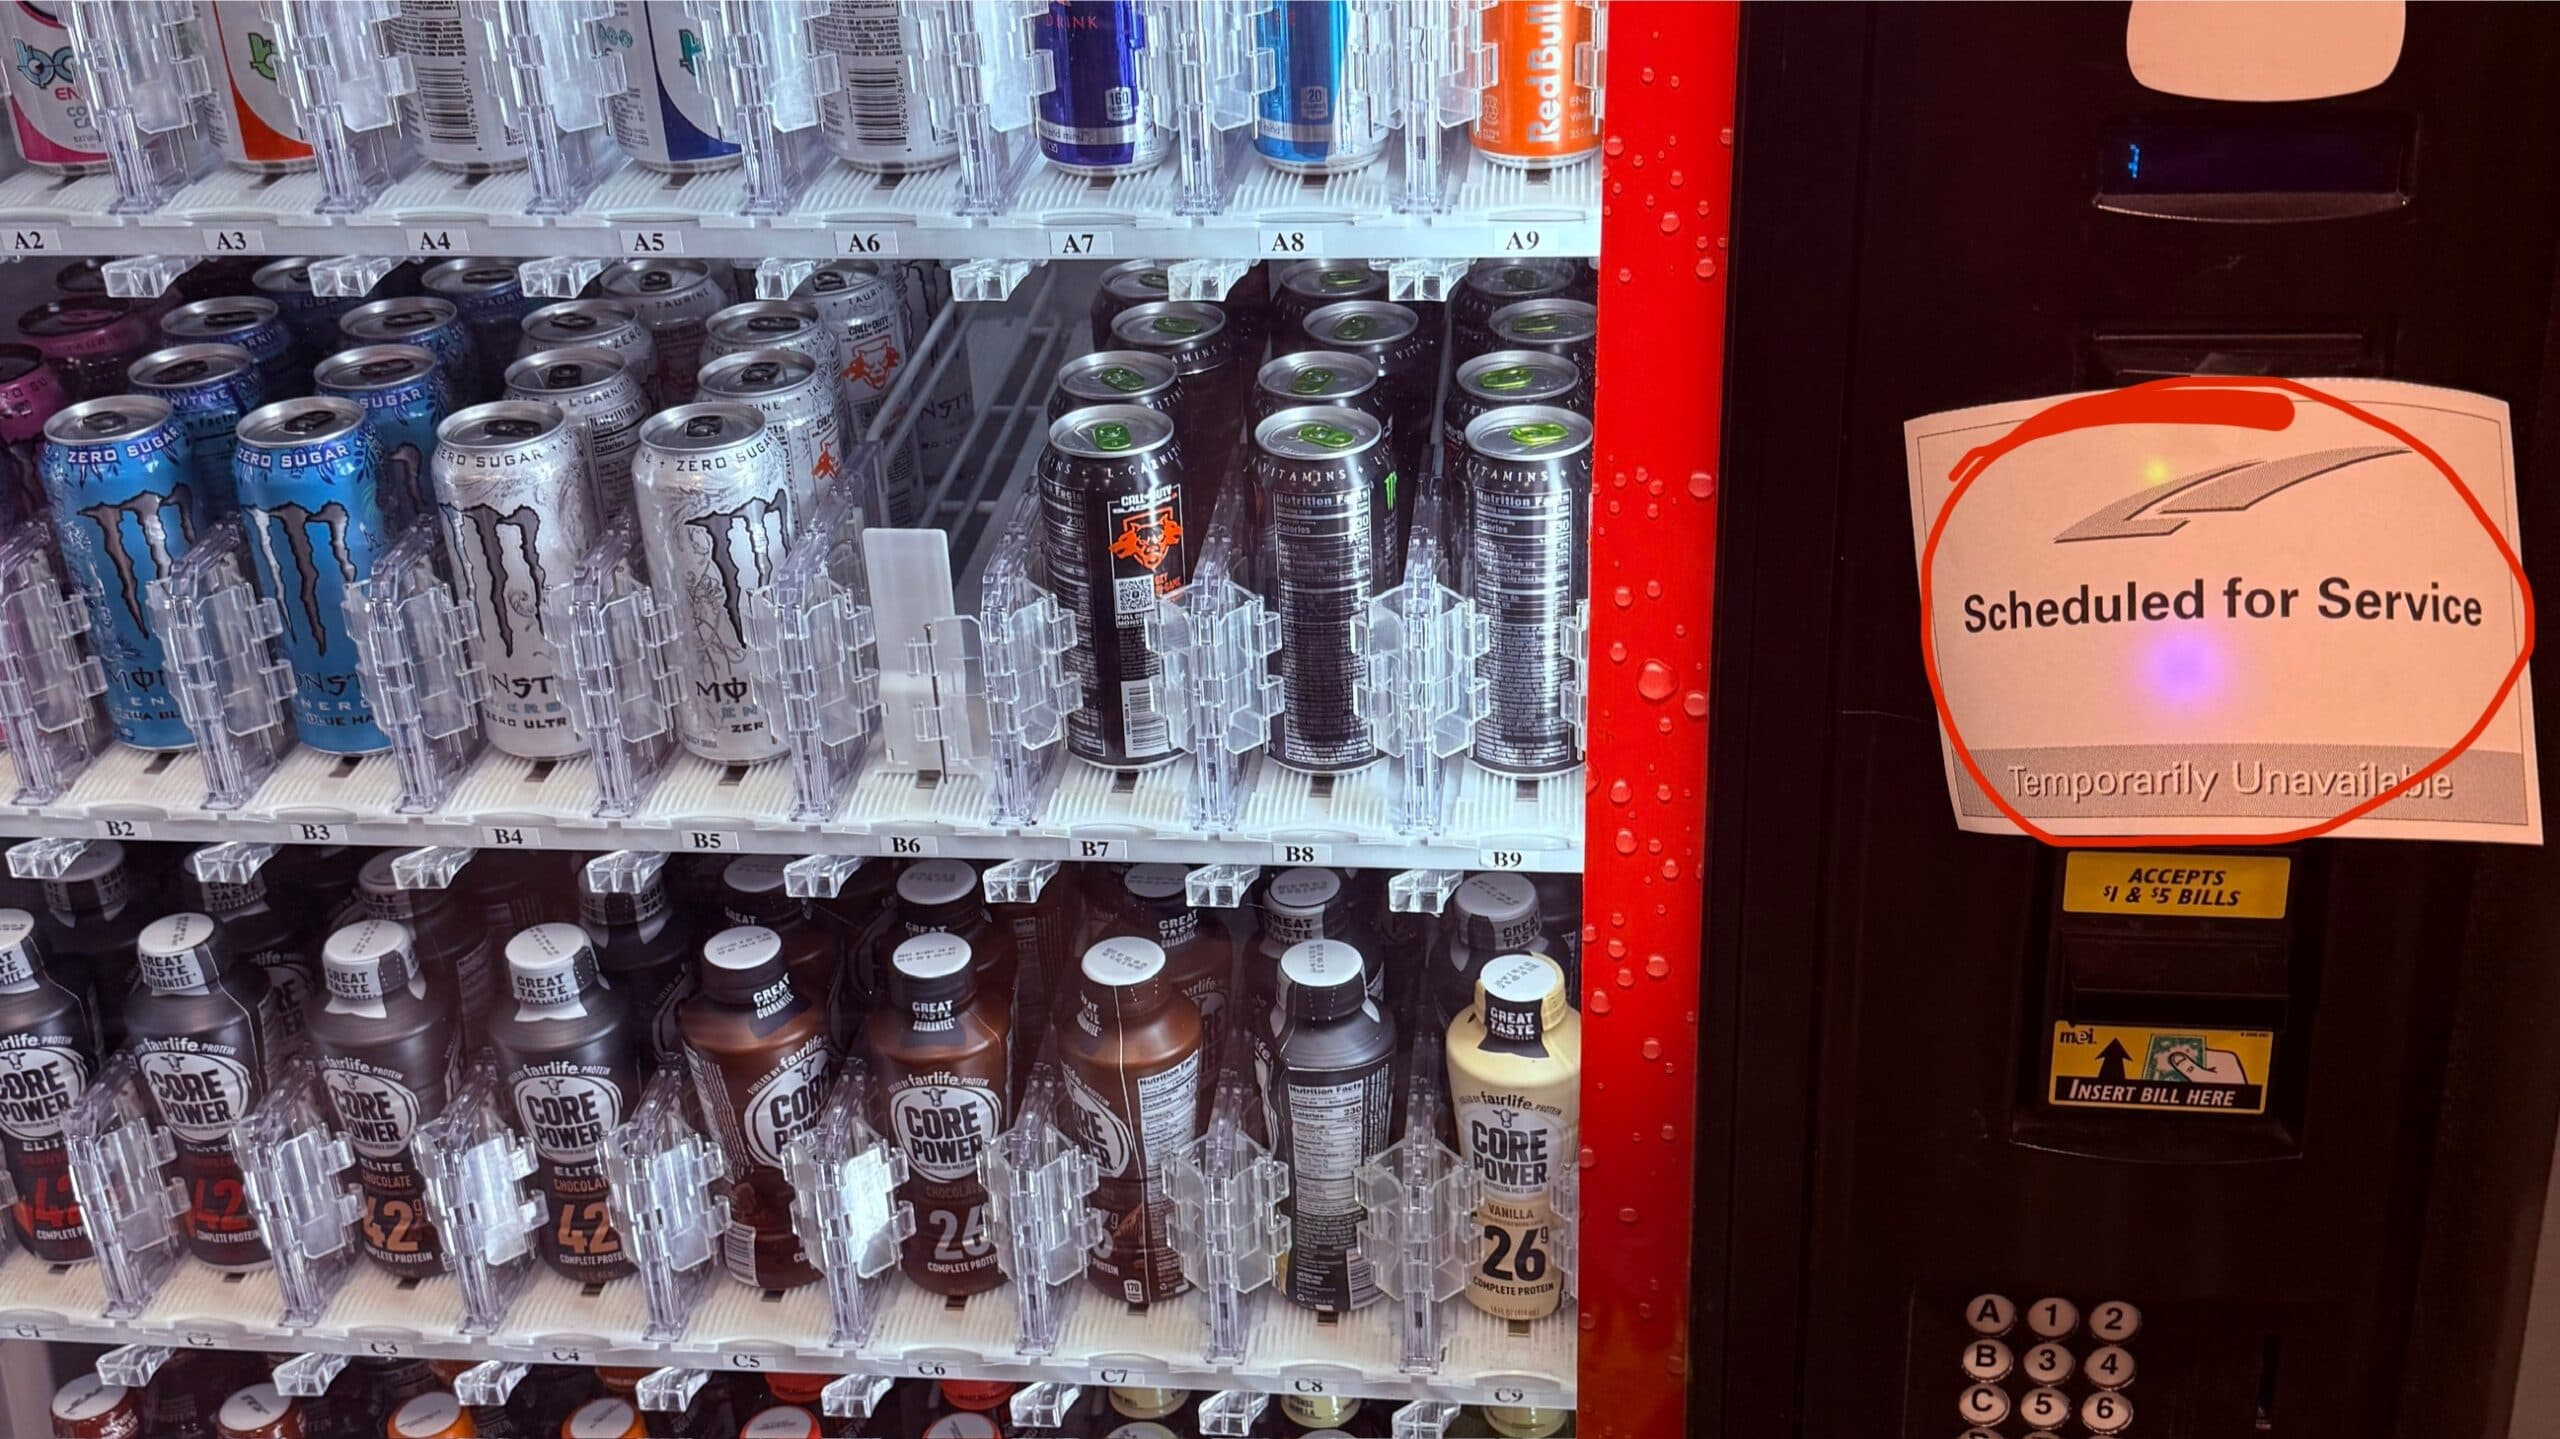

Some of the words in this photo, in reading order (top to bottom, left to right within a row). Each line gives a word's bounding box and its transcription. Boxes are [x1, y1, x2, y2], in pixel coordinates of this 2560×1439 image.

[1110, 92, 1129, 106] 160
[1308, 90, 1321, 102] 20
[14, 232, 44, 250] A2
[217, 232, 246, 250] A3
[420, 232, 450, 250] A4
[634, 234, 663, 252] A5
[849, 234, 880, 252] A6
[1064, 234, 1093, 253] A7
[1272, 233, 1304, 251] A8
[1507, 232, 1539, 250] A9
[68, 449, 117, 463] ZERO
[126, 426, 180, 457] SUGAR
[238, 448, 271, 467] ZERO
[281, 444, 348, 468] SUGAR
[477, 449, 544, 468] SUGAR
[676, 460, 727, 472] ZERO
[1262, 463, 1346, 482] VITAMINS
[1277, 493, 1332, 506] Nutrition
[1477, 492, 1530, 507] Nutrition
[1964, 577, 2205, 633] Scheduled
[2224, 576, 2299, 619] for
[2318, 575, 2484, 627] Service
[2009, 764, 2218, 803] Temporarily
[2233, 762, 2455, 800] Unavailable
[108, 821, 135, 837] B2
[302, 824, 330, 840] B3
[496, 830, 523, 845] B4
[694, 832, 721, 848] B5
[893, 838, 920, 853] B6
[1081, 841, 1109, 857] B7
[1285, 846, 1314, 863] B8
[1493, 851, 1522, 867] B9
[2128, 868, 2227, 886] ACCEPTS
[2103, 886, 2118, 903] $1
[2126, 889, 2141, 903] &
[2152, 887, 2171, 904] $5
[2177, 889, 2241, 906] BILLS
[1158, 910, 1199, 930] GREAT
[144, 965, 188, 977] TASTE
[516, 973, 565, 988] GREAT
[753, 972, 791, 1003] GREAT
[518, 985, 567, 998] TASTE
[912, 1000, 953, 1013] GREAT
[1490, 1007, 1534, 1024] GREAT
[1490, 1020, 1535, 1035] TASTE
[2060, 1028, 2092, 1045] mei
[202, 1044, 236, 1055] PROTEIN
[780, 1035, 823, 1070] fairlife
[373, 1066, 404, 1080] PROTEIN
[523, 1061, 579, 1078] fairlife
[581, 1066, 611, 1075] PROTEIN
[1140, 1065, 1179, 1086] Nutrition
[150, 1069, 225, 1102] CORE
[908, 1072, 960, 1087] fairlife
[961, 1077, 990, 1087] PROTEIN
[1290, 1085, 1333, 1095] Nutrition
[1336, 1083, 1362, 1093] Facts
[2069, 1078, 2136, 1102] INSERT
[2140, 1087, 2179, 1104] BILL
[2187, 1089, 2236, 1107] HERE
[163, 1100, 232, 1124] POWER
[526, 1090, 600, 1126] CORE
[1344, 1106, 1361, 1116] 230
[1481, 1091, 1533, 1110] fairlife
[1535, 1104, 1562, 1116] PROTEIN
[904, 1102, 981, 1140] CORE
[535, 1121, 603, 1148] POWER
[1471, 1120, 1547, 1162] CORE
[910, 1135, 983, 1163] POWER
[1473, 1151, 1550, 1186] POWER
[1488, 1203, 1534, 1219] VANILLA
[394, 1249, 433, 1263] PROTEIN
[560, 1252, 596, 1265] COMPLETE
[927, 1262, 970, 1273] COMPLETE
[1126, 1282, 1140, 1292] 170
[1473, 1276, 1516, 1295] COMPLETE
[1518, 1283, 1554, 1296] PROTEIN
[1977, 1300, 2000, 1323] A
[2045, 1304, 2057, 1327] 1
[2105, 1309, 2122, 1330] 2
[187, 1334, 215, 1346] C2
[371, 1343, 398, 1354] C3
[553, 1349, 580, 1362] C4
[733, 1354, 760, 1368] C5
[1975, 1345, 1997, 1368] B
[2039, 1349, 2056, 1372] 3
[2100, 1354, 2118, 1375] 4
[918, 1363, 946, 1376] C6
[1101, 1369, 1128, 1383] C7
[1295, 1379, 1323, 1392] C8
[1494, 1389, 1524, 1402] C9
[1971, 1389, 1993, 1412] C
[2034, 1394, 2051, 1415] 5
[2097, 1398, 2114, 1419] 6
